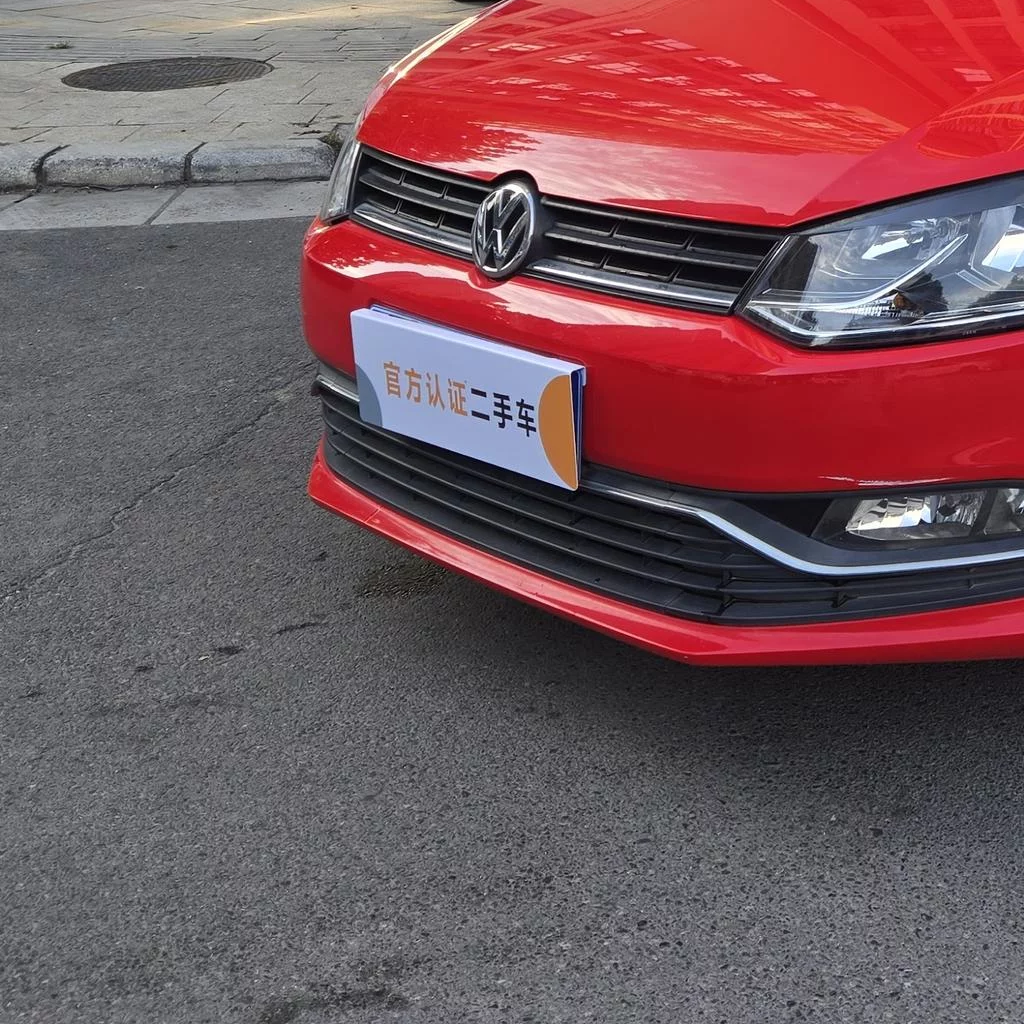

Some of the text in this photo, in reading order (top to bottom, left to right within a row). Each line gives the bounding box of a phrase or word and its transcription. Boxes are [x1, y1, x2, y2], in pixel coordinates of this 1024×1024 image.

[383, 361, 538, 438] 官方认证二手车
